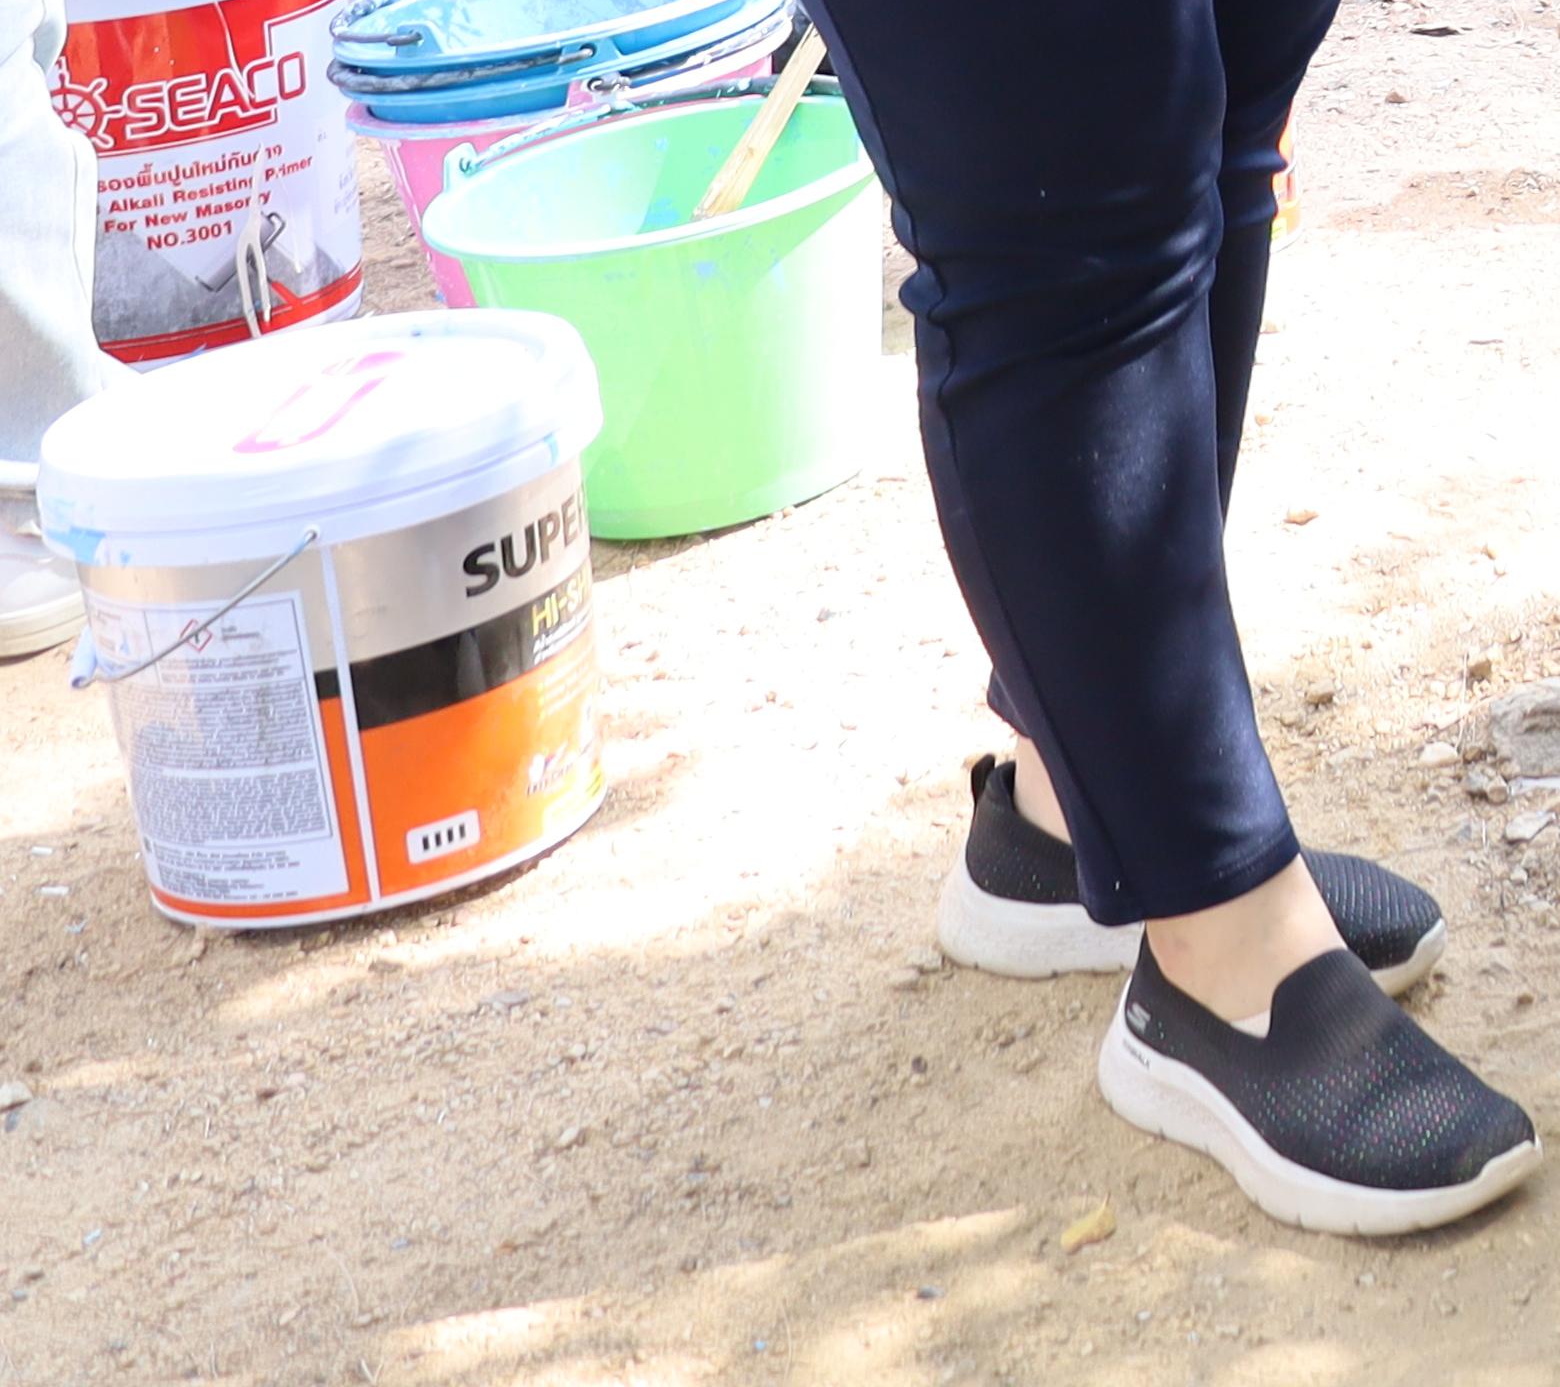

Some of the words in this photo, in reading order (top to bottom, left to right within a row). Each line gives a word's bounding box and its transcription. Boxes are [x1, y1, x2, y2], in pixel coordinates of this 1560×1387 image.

[125, 51, 306, 140] SEACO
[109, 194, 165, 215] Alkali
[104, 218, 137, 234] For
[145, 211, 188, 230] New
[146, 219, 233, 251] NO.3001
